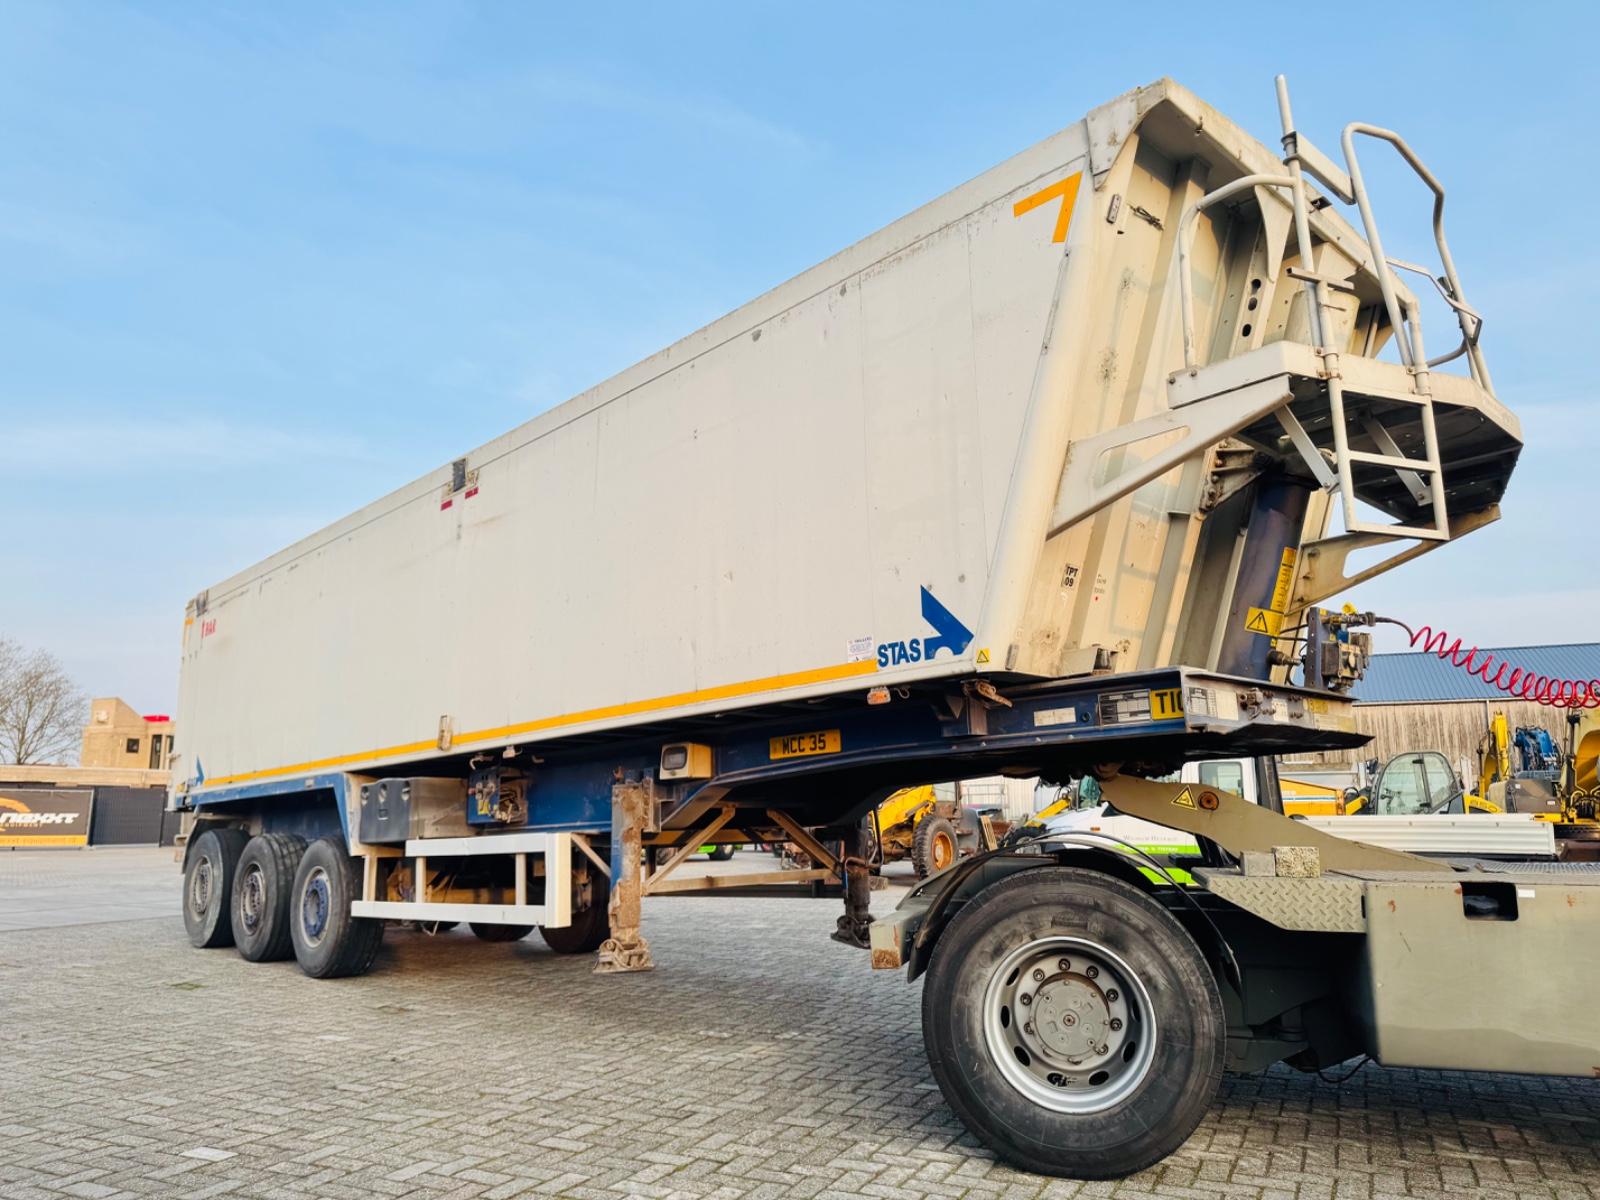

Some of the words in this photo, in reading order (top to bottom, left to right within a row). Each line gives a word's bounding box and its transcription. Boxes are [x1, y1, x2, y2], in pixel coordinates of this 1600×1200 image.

[1065, 566, 1079, 577] TPT
[877, 638, 922, 667] STAS
[782, 736, 806, 754] MCC
[809, 733, 827, 751] 35
